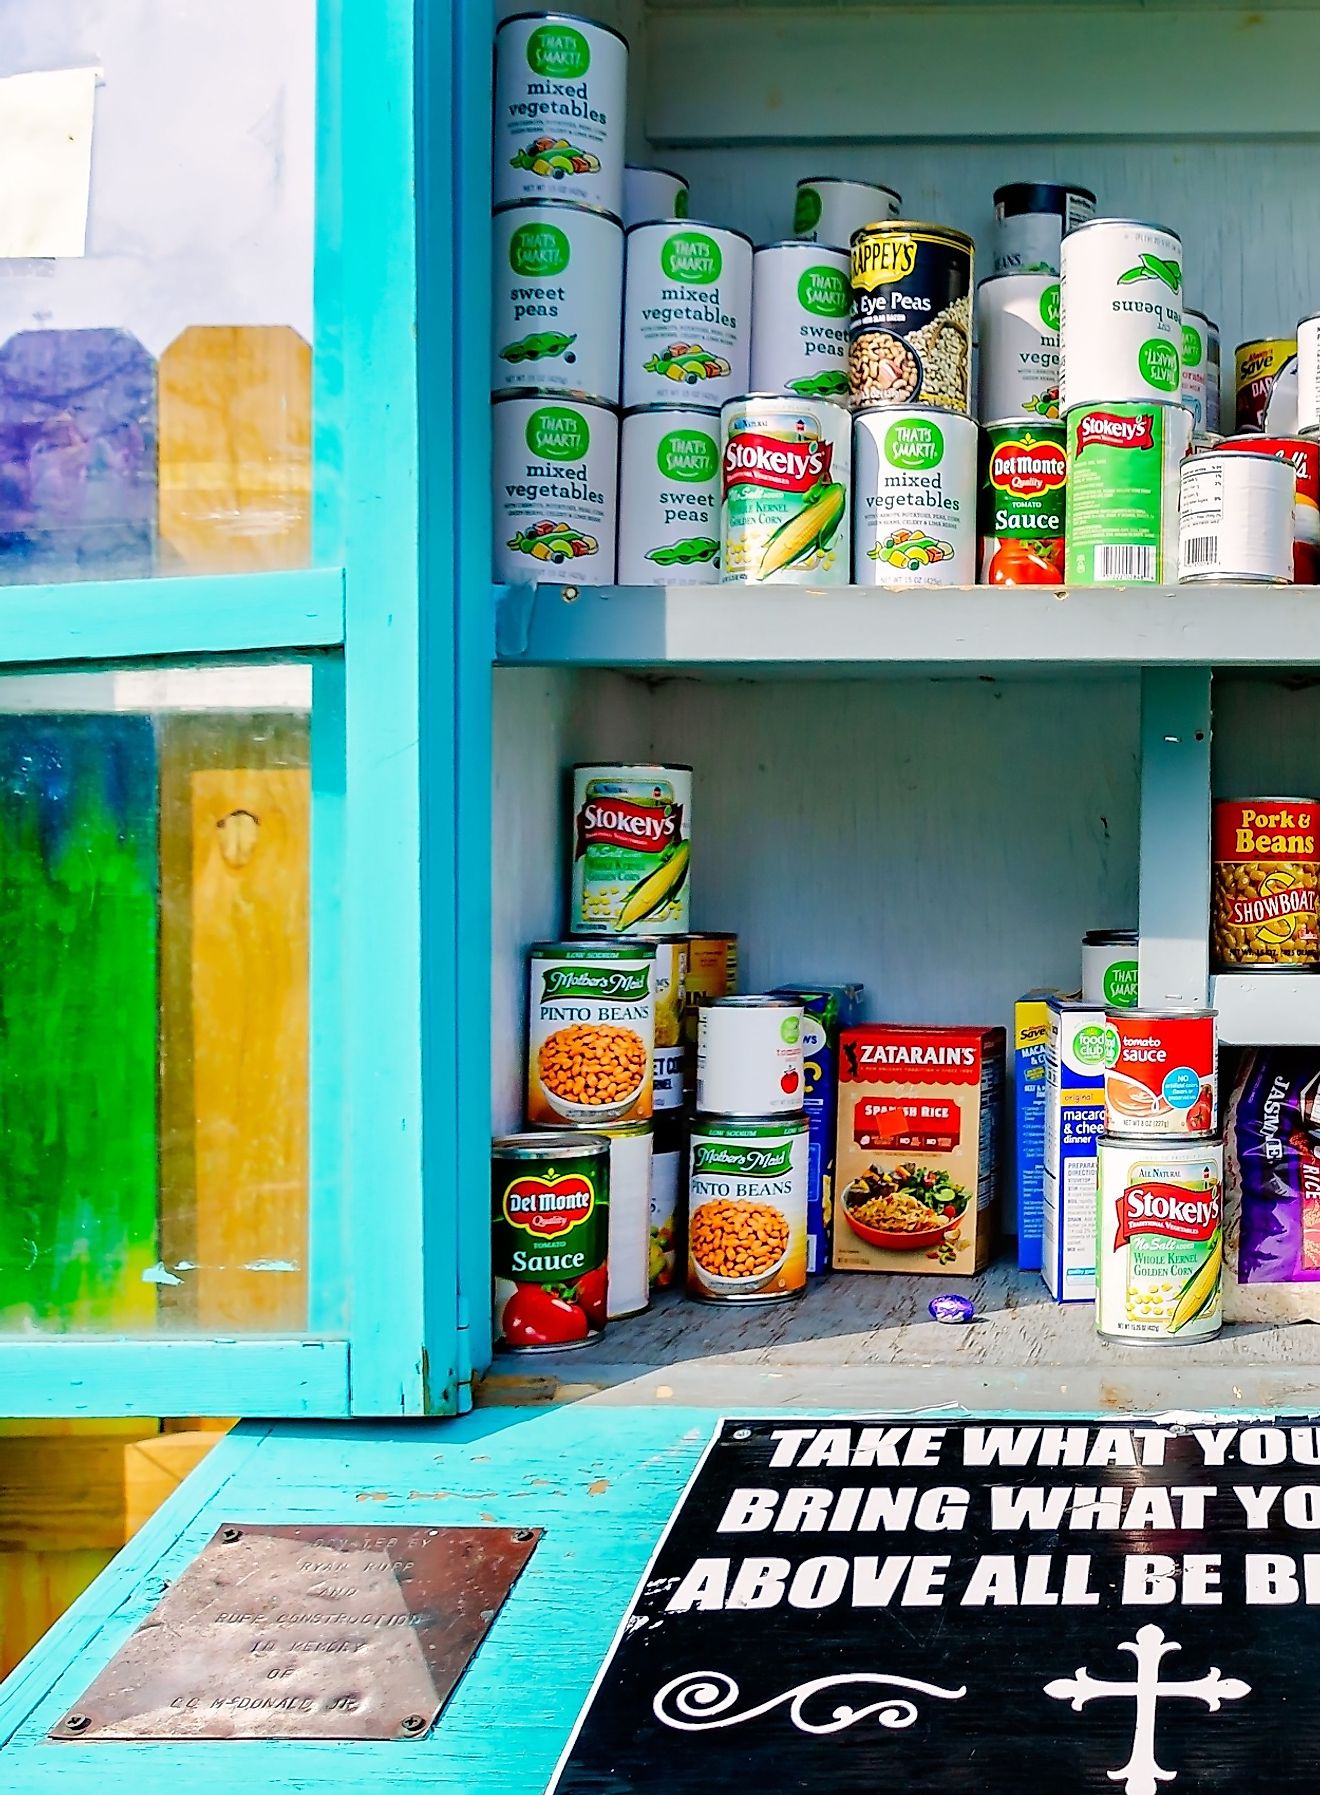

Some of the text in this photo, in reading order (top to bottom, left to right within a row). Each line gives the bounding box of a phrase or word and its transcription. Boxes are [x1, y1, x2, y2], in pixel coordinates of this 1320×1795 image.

[527, 80, 588, 100] mixed
[508, 100, 607, 124] vegetables
[510, 287, 565, 302] sweet
[661, 288, 720, 306] mixed
[860, 291, 932, 315] Eye Peas
[1112, 300, 1163, 322] beans
[514, 303, 558, 321] peas
[642, 305, 737, 329] vegetables
[800, 325, 850, 343] sweet
[804, 342, 844, 357] peas
[1240, 355, 1274, 380] Save
[539, 416, 577, 432] THAT'S
[1081, 416, 1147, 441] Stokely's
[535, 430, 581, 449] SMART!
[894, 427, 932, 442] THAT'S
[669, 437, 706, 452] THAT'S
[891, 442, 937, 460] SMART!
[665, 452, 711, 471] SMART!
[725, 442, 825, 479] Stokely's
[994, 457, 1064, 476] Del Monte
[526, 462, 588, 482] mixed
[884, 473, 942, 489] mixed
[1011, 477, 1043, 489] Quality
[505, 482, 604, 505] vegetables
[659, 492, 715, 507] sweet
[865, 492, 960, 511] vegetables
[664, 507, 709, 524] peas
[755, 502, 789, 514] KERNEL
[758, 513, 783, 525] CORN
[995, 510, 1060, 530] Sauce
[584, 804, 675, 841] Stokely's
[1242, 809, 1311, 829] Pork &
[1235, 828, 1315, 854] Beans
[1235, 890, 1317, 923] SHOWBOAT
[540, 1005, 649, 1021] PINTO BEANS
[1020, 1028, 1046, 1041] Save
[1078, 1033, 1105, 1045] food
[1122, 1036, 1161, 1047] tomato
[860, 1045, 976, 1066] ZATARAIN'S
[1079, 1043, 1105, 1055] club
[1122, 1049, 1167, 1062] sauce
[1177, 1074, 1189, 1082] NO
[1064, 1093, 1094, 1103] original
[921, 1105, 949, 1118] RICE
[1063, 1123, 1073, 1135] &
[1153, 1120, 1169, 1128] (227g)
[1063, 1135, 1092, 1144] dinner
[1138, 1168, 1182, 1178] ALL NATURAL
[735, 1180, 792, 1197] BEANS
[510, 1192, 590, 1212] Del Monte
[1126, 1189, 1220, 1227] Stokely's
[532, 1214, 567, 1228] Quality
[533, 1241, 567, 1249] TOMATO
[1134, 1238, 1149, 1250] No
[1150, 1238, 1177, 1250] Salt
[511, 1251, 585, 1272] Sauce
[1133, 1252, 1198, 1265] WHOLE KERNEL
[1133, 1264, 1193, 1277] GOLDEN CORN
[769, 1427, 955, 1468] TAKE
[963, 1427, 1173, 1468] WHAT
[717, 1486, 971, 1533] BRING
[991, 1485, 1217, 1532] WHAT
[300, 1561, 415, 1573] RYAN RUPP
[664, 1554, 951, 1611] ABOVE
[959, 1554, 1100, 1608] ALL
[1122, 1553, 1223, 1606] BE
[320, 1586, 359, 1598] AND
[275, 1612, 423, 1627] CONSTRUCTION
[289, 1639, 368, 1653] MEMORY
[266, 1667, 296, 1680] OF
